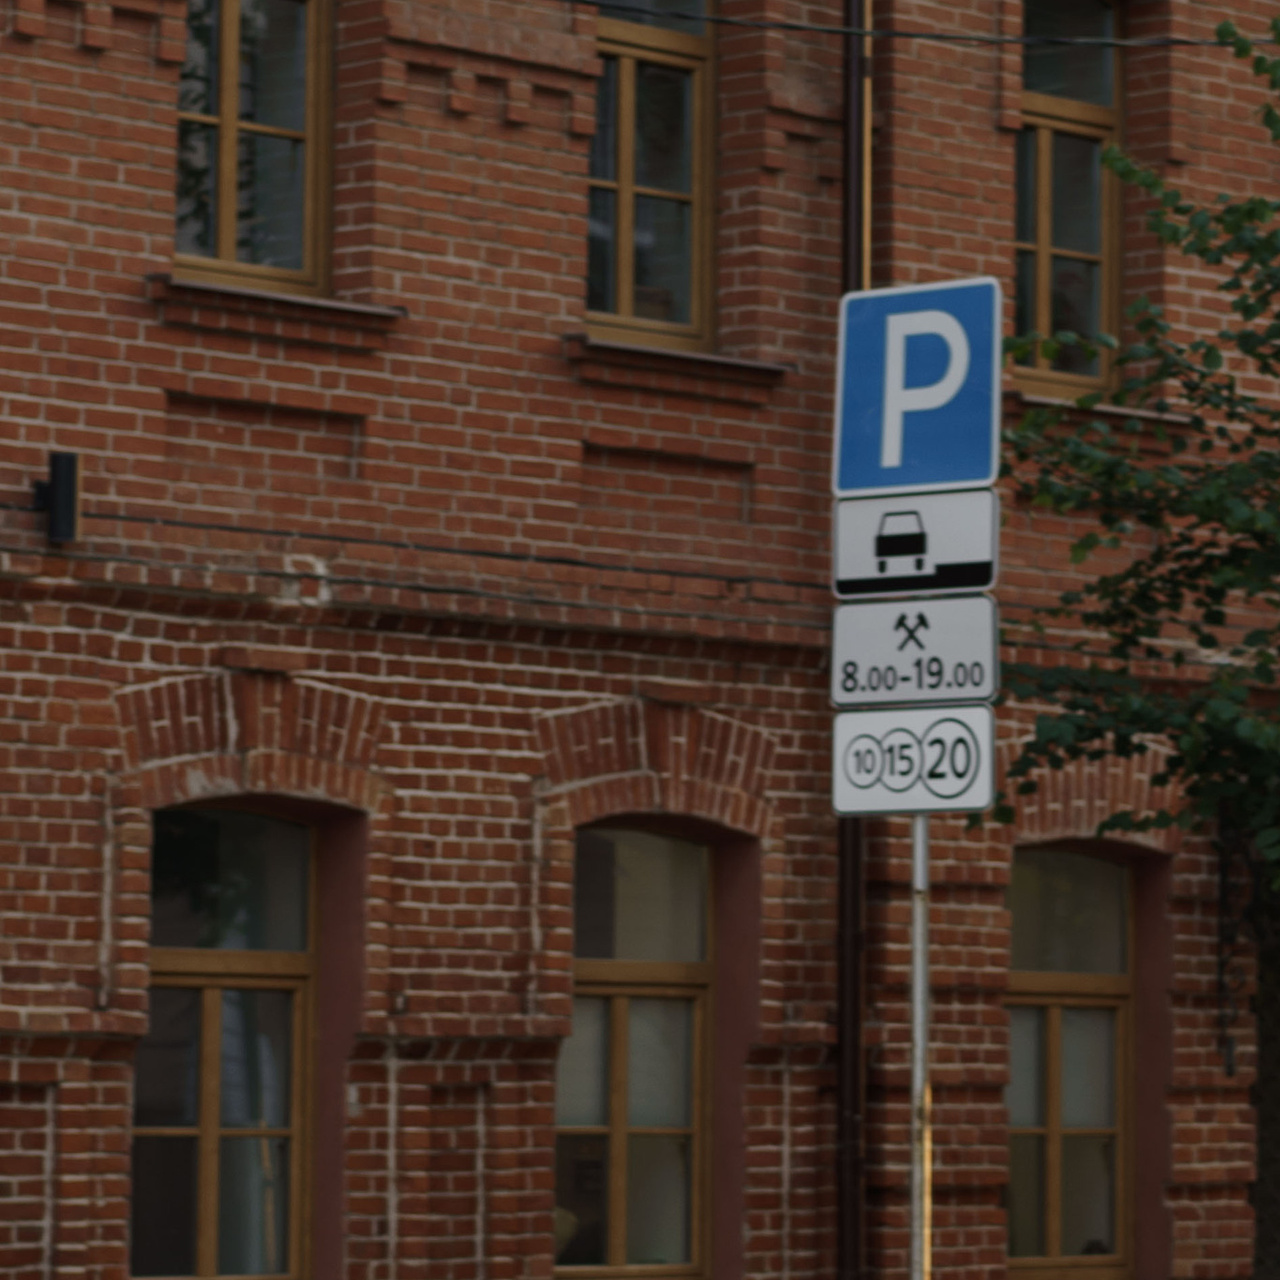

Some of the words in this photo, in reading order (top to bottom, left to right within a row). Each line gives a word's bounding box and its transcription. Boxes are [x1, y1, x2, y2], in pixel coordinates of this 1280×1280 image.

[880, 309, 970, 469] P
[841, 656, 985, 693] 8.00-19.00
[853, 748, 876, 775] 10
[886, 743, 915, 777] 15
[927, 736, 972, 780] 20
